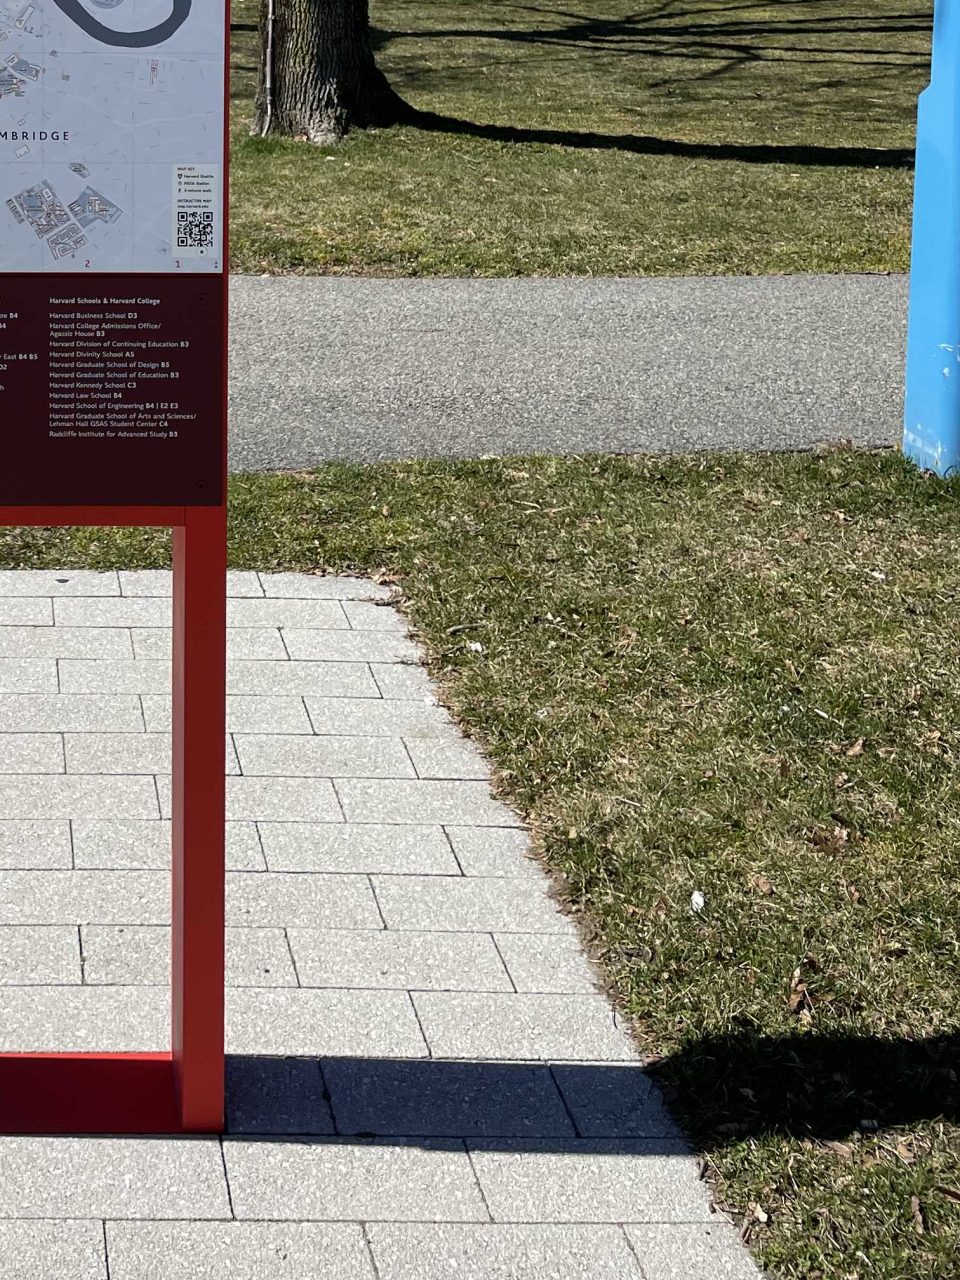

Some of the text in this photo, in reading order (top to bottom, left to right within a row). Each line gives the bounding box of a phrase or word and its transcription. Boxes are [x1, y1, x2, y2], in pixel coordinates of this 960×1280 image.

[84, 259, 90, 268] 2
[175, 260, 180, 268] 1
[136, 297, 161, 306] College
[49, 322, 162, 331] Harvard College Admissions Office/
[49, 330, 73, 339] Agassiz
[49, 340, 75, 348] Harvard
[75, 340, 102, 348] Division
[111, 340, 147, 349] Continuing
[147, 340, 179, 348] Education
[76, 351, 101, 359] Divinity
